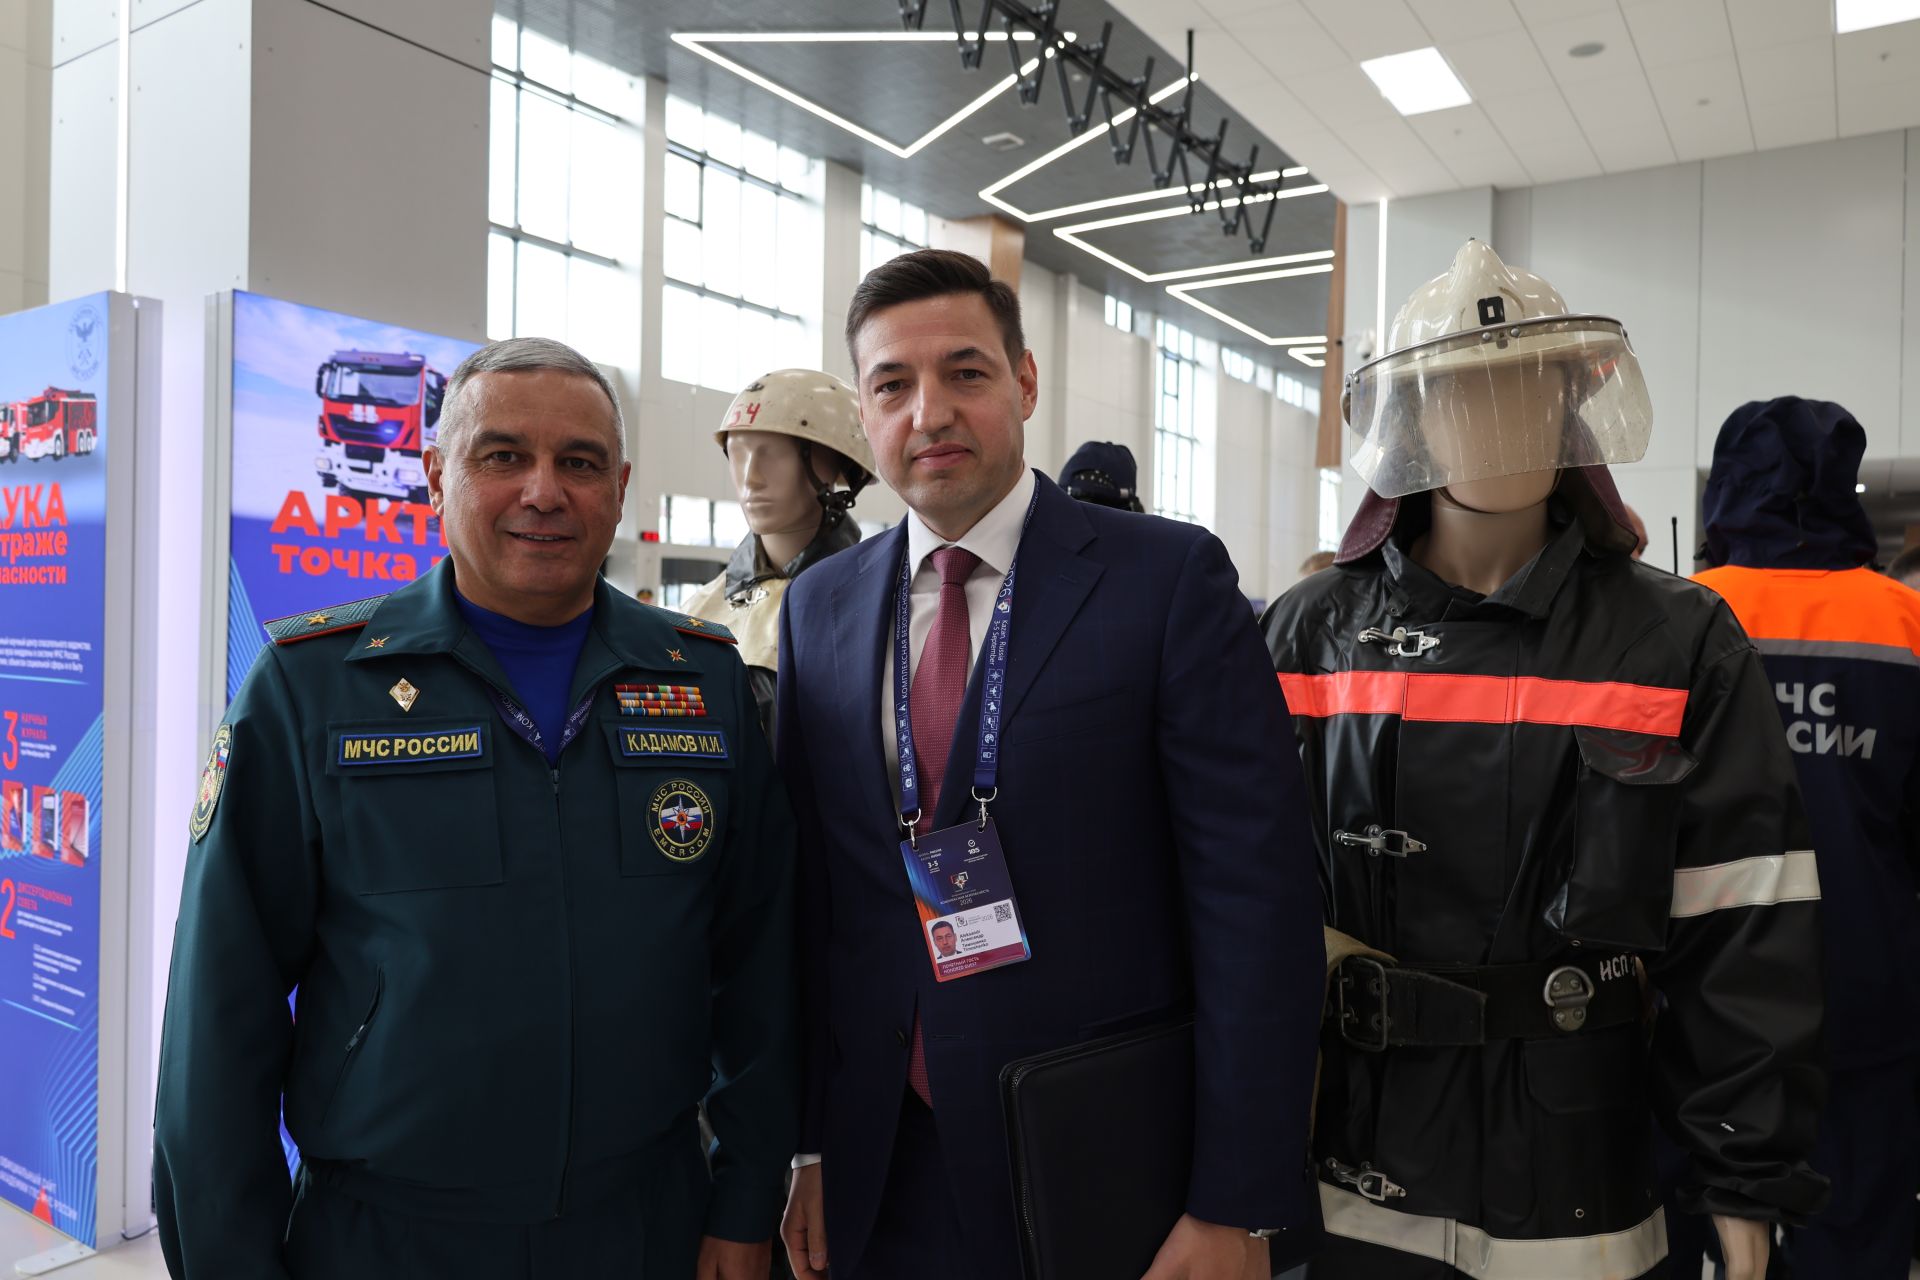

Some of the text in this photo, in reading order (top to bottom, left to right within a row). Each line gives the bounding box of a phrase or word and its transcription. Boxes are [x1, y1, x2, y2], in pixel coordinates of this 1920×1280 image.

[0, 482, 67, 529] УКА
[0, 530, 68, 564] траже
[271, 544, 416, 581] точка
[0, 565, 67, 584] асности
[989, 631, 999, 665] September
[998, 641, 1006, 661] Russia
[1775, 682, 1836, 716] ЧС
[2, 710, 18, 771] 3
[344, 732, 478, 759] МЧС РОССИИ
[627, 733, 724, 753] КАДАМОВ И.И.
[1785, 720, 1877, 759] СИИ
[651, 782, 710, 814] МЧС РОССИИ
[653, 827, 710, 856] EMERCOM
[927, 860, 939, 869] 3-5
[0, 877, 16, 940] 2
